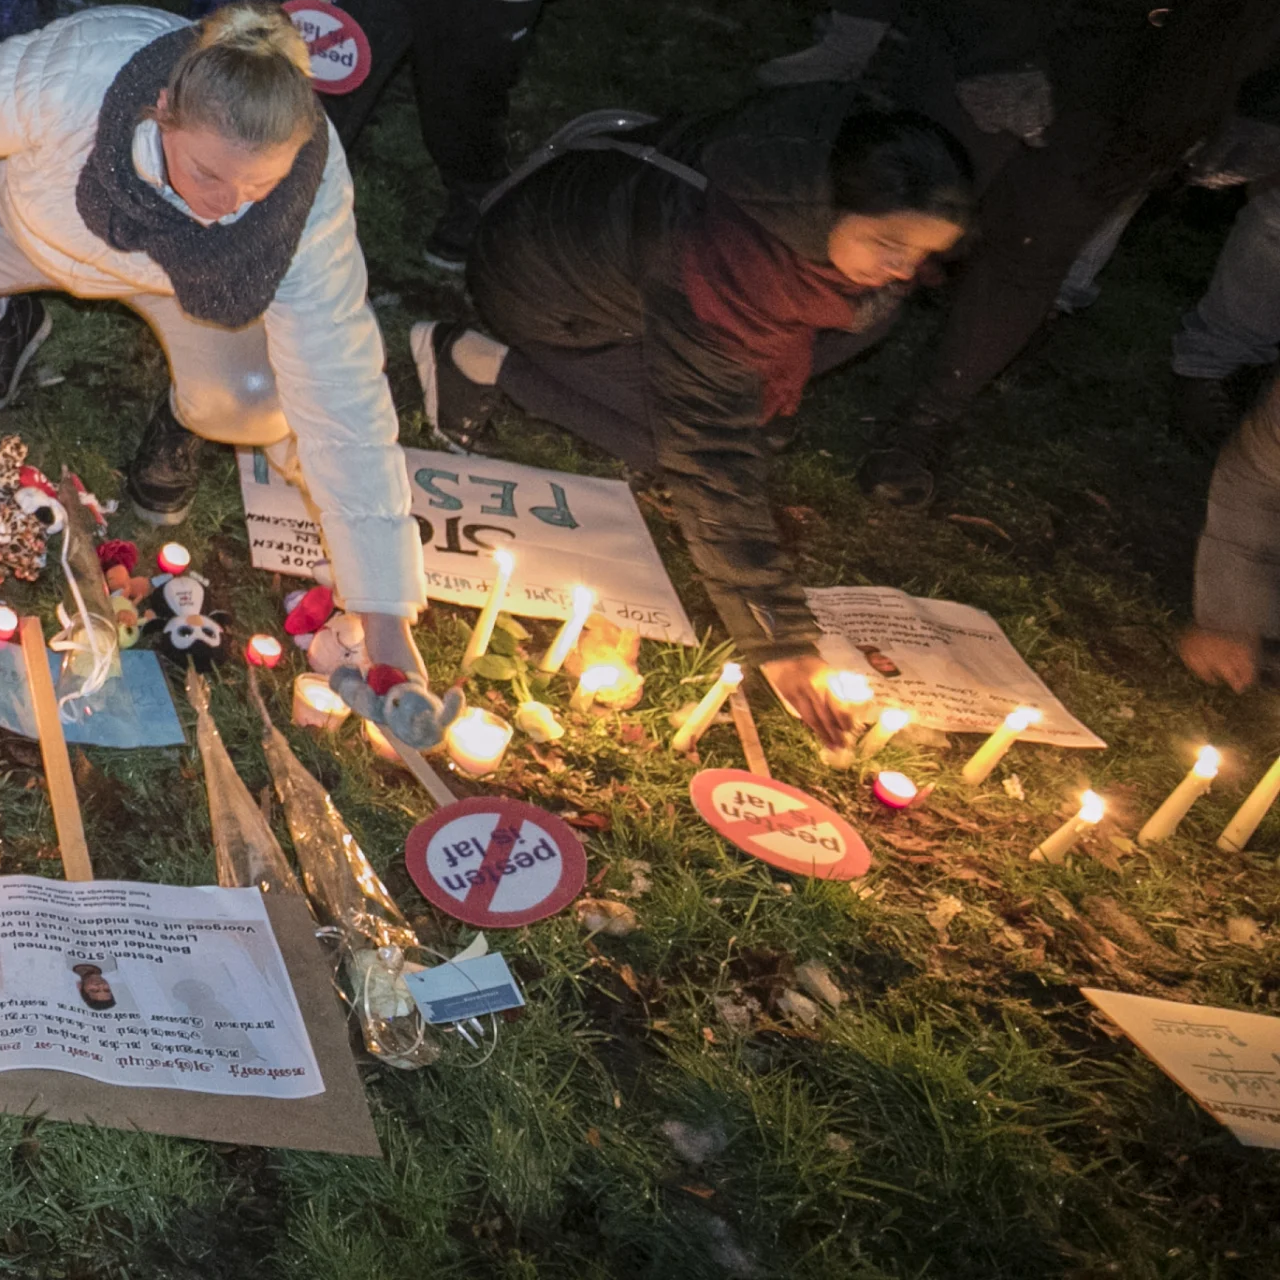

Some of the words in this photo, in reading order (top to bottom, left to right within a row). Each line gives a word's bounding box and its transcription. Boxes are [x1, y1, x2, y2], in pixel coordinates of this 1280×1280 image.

[616, 604, 672, 628] STOP
[733, 790, 776, 817] laf
[788, 809, 818, 831] is
[720, 802, 841, 853] pesten
[490, 825, 526, 846] is
[440, 836, 486, 868] laf
[441, 837, 557, 891] pesten
[34, 911, 69, 923] maar
[73, 916, 130, 926] midden,
[133, 918, 159, 928] ons
[17, 920, 31, 928] in
[35, 921, 63, 933] rust
[163, 923, 183, 931] uit
[186, 923, 256, 934] Voorgoed
[44, 932, 70, 943] met
[66, 926, 155, 941] Tharukshan,
[160, 933, 198, 942] Lieve
[12, 942, 62, 953] ermee!
[74, 939, 119, 949] elkaar
[124, 940, 191, 955] Behandel
[67, 949, 105, 960] STOP
[109, 950, 163, 964] Pesten,
